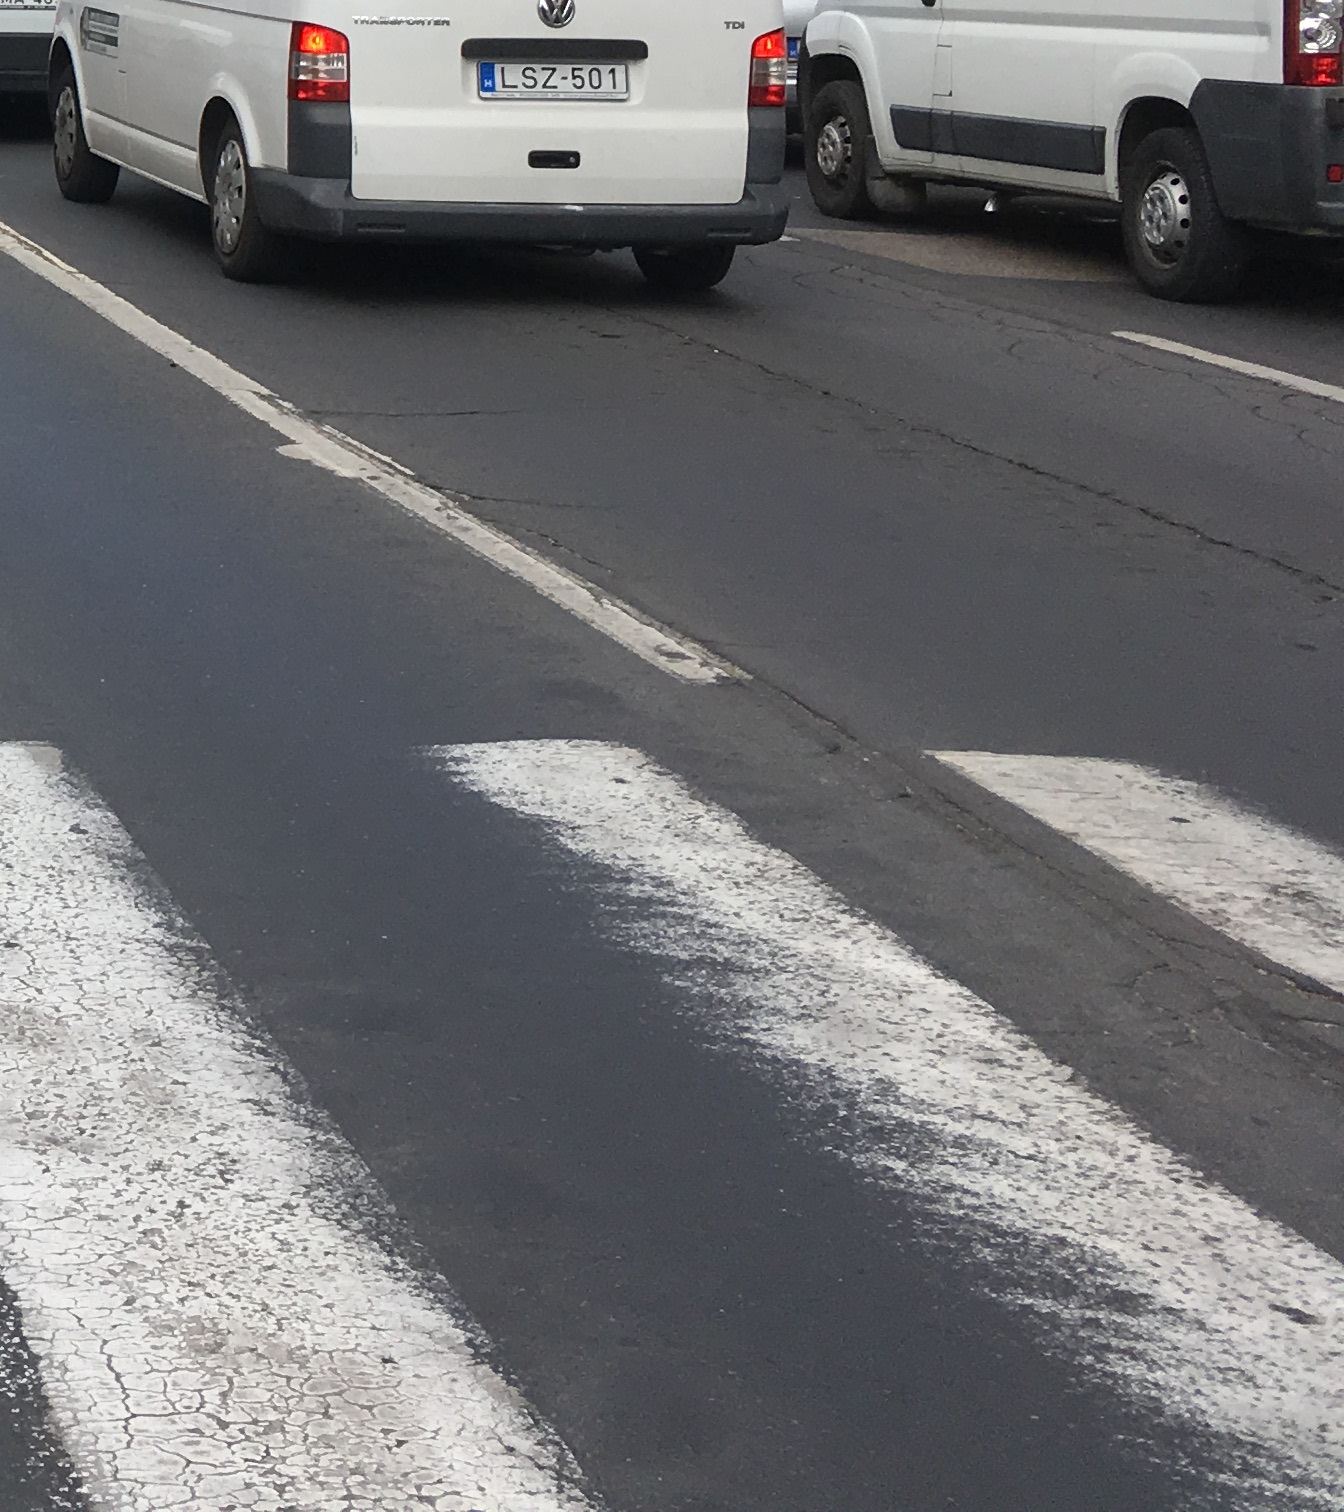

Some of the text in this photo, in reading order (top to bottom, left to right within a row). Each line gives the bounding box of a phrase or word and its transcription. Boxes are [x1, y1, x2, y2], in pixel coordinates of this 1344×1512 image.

[352, 15, 451, 26] TRANSPORTER
[724, 21, 746, 30] TDI
[500, 66, 619, 90] LSZ-501
